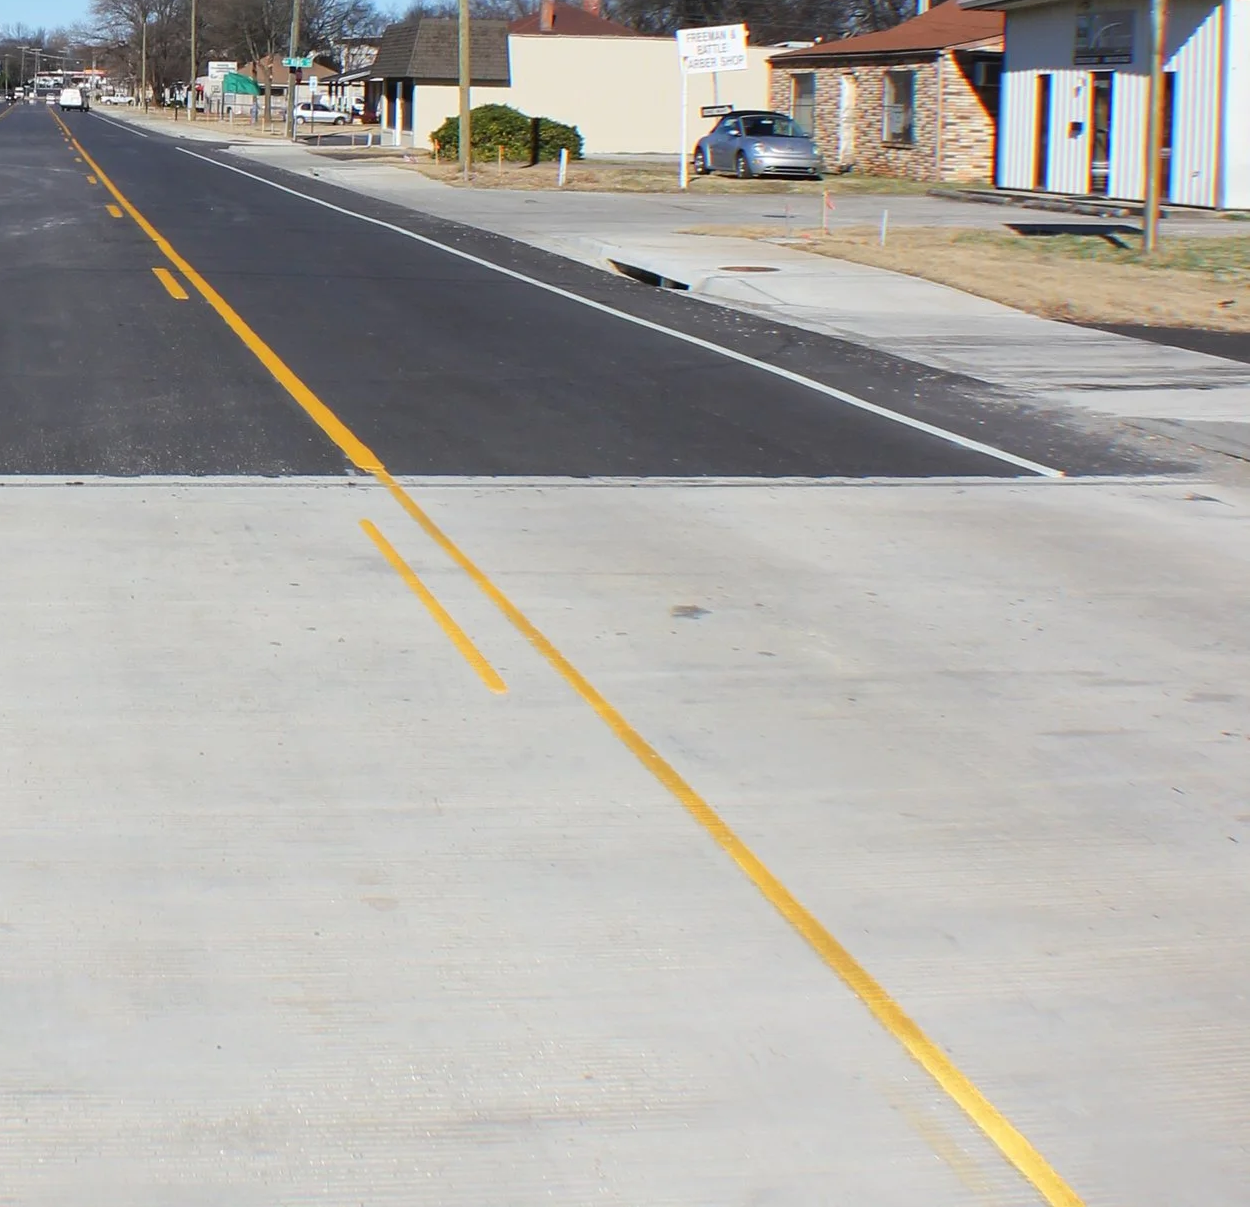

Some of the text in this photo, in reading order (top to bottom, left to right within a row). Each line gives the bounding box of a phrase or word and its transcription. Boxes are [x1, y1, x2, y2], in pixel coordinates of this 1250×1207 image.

[686, 29, 727, 42] FREEMAN
[697, 43, 727, 55] BATTLE
[686, 55, 744, 69] ARBER SHOP
